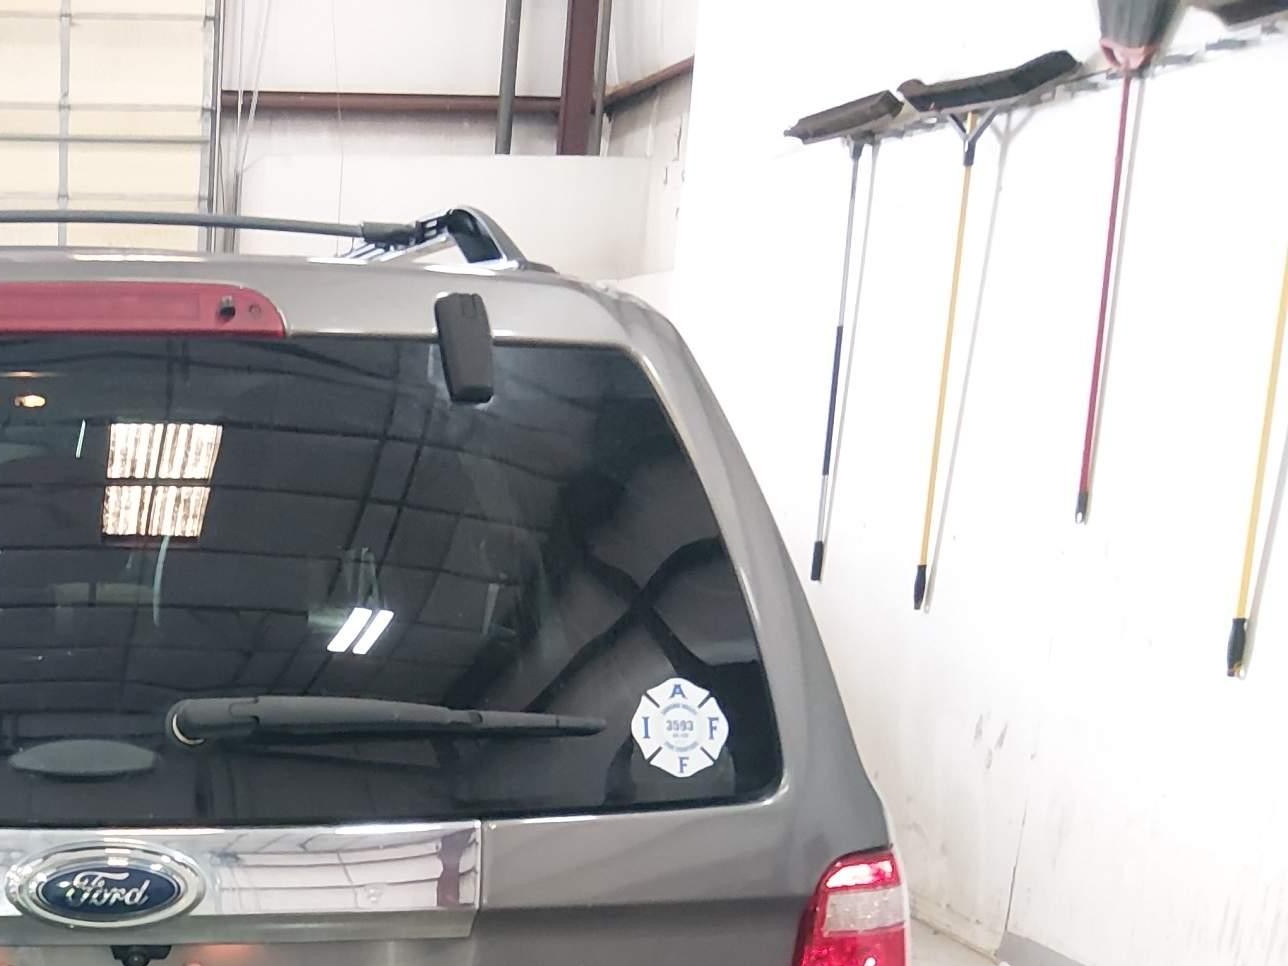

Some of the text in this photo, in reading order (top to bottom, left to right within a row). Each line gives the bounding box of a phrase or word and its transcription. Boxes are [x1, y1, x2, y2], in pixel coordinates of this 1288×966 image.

[669, 684, 688, 699] A
[642, 716, 651, 739] I
[707, 716, 719, 740] F
[678, 756, 689, 774] F
[65, 871, 152, 907] Ford
